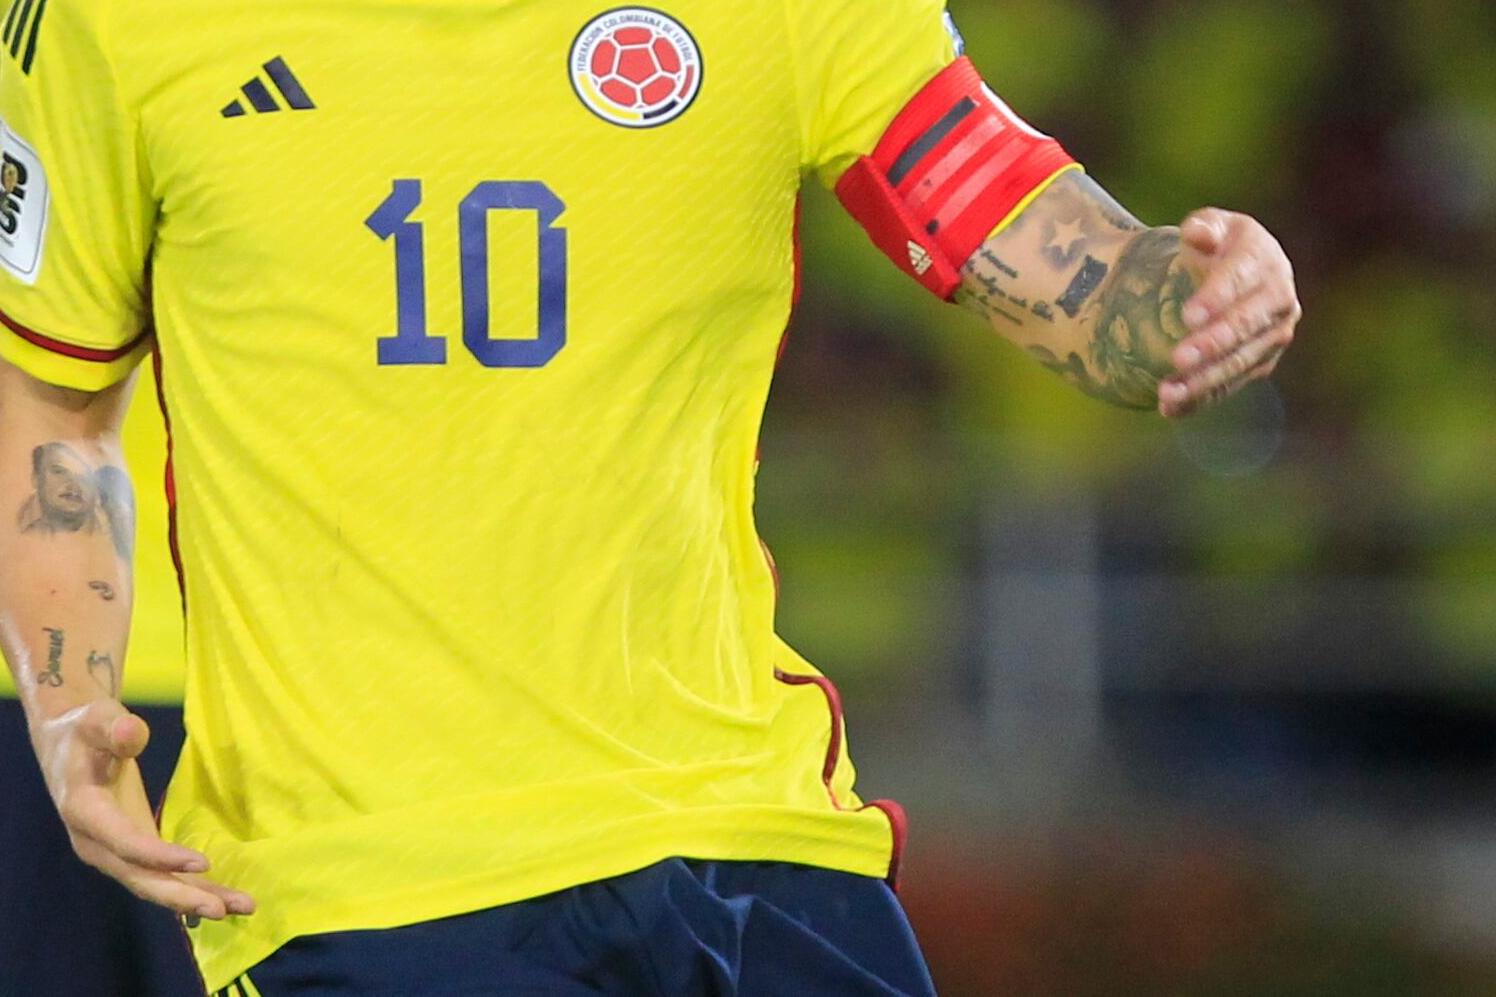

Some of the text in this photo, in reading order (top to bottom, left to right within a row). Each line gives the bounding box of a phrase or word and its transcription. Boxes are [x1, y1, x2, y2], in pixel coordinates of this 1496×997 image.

[604, 14, 662, 29] COLOMBIANA
[662, 23, 673, 34] DE
[364, 178, 567, 367] 10
